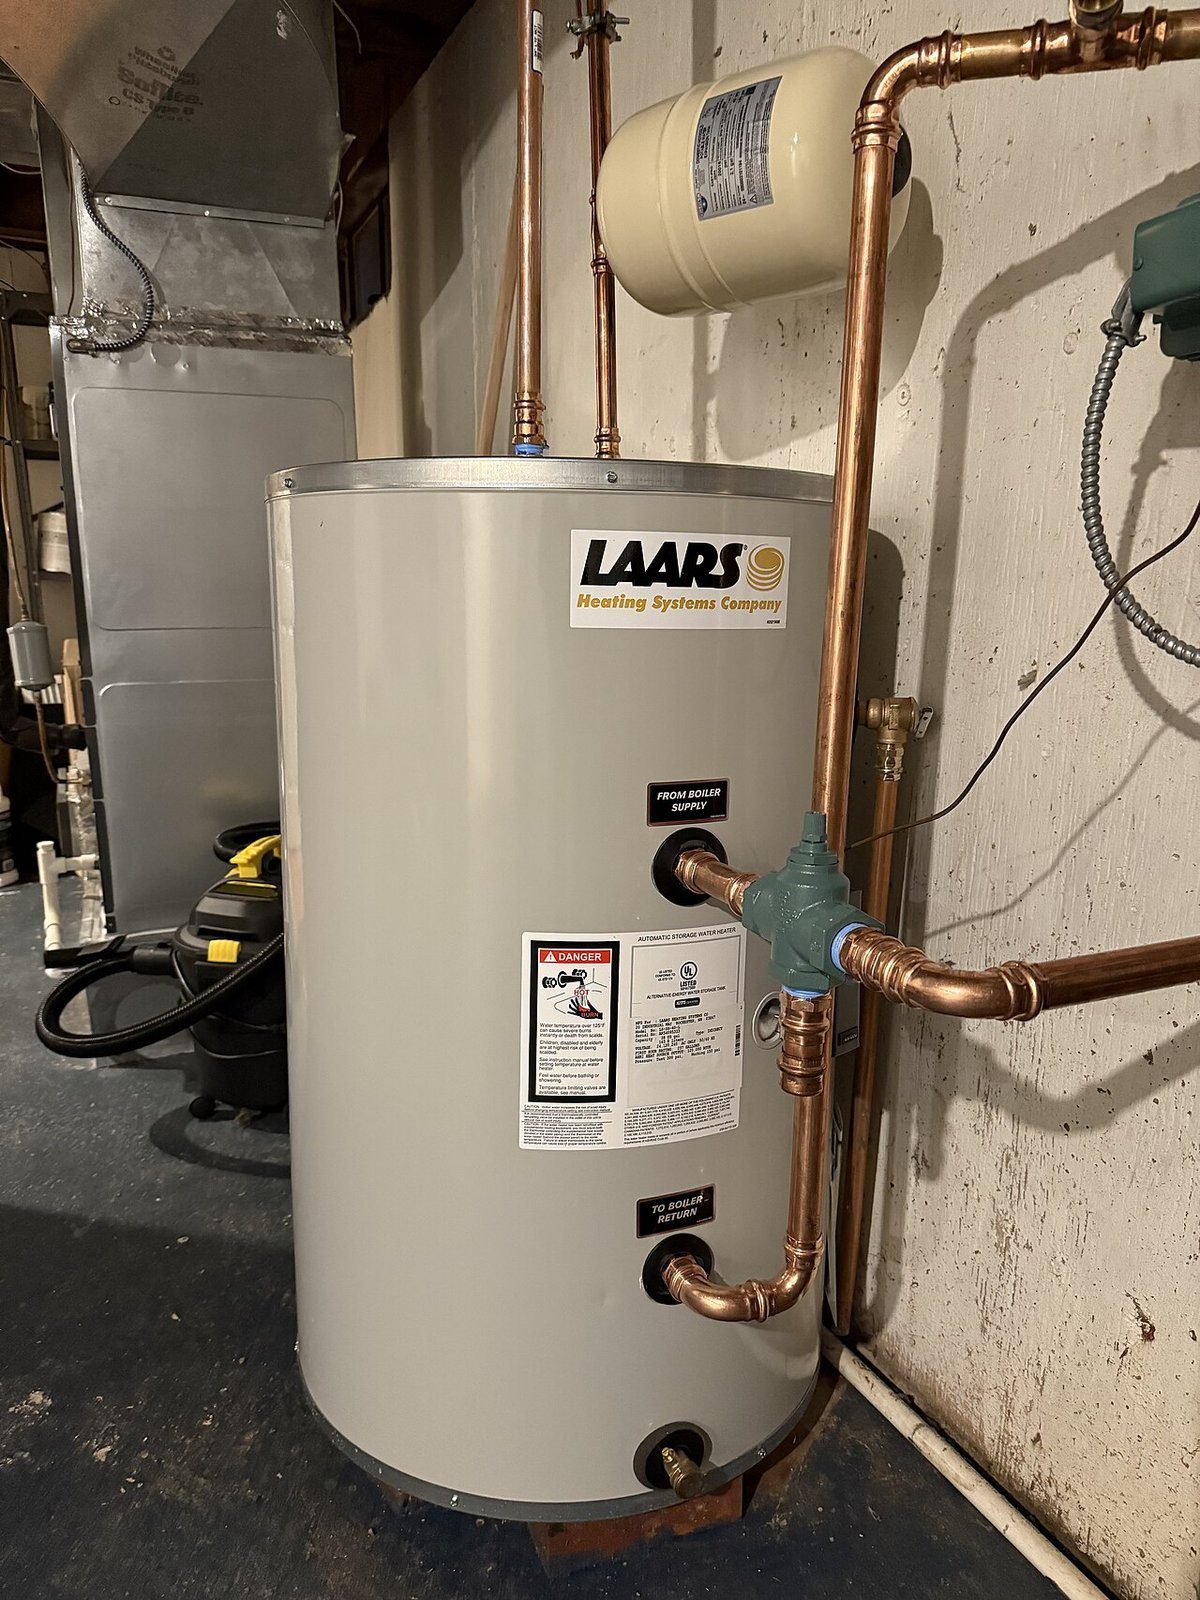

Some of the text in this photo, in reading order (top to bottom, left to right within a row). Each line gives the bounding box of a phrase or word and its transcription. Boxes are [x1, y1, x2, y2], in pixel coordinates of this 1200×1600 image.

[580, 539, 744, 589] LAARS
[577, 594, 783, 613] Heating Systems Company
[657, 788, 721, 800] FROM BOILER
[671, 801, 708, 812] SUPPLY
[672, 932, 697, 940] STORAGE
[698, 929, 716, 937] WATER
[559, 953, 602, 961] DANGER
[652, 1195, 703, 1214] TO BOILER
[657, 1207, 698, 1224] RETURN
